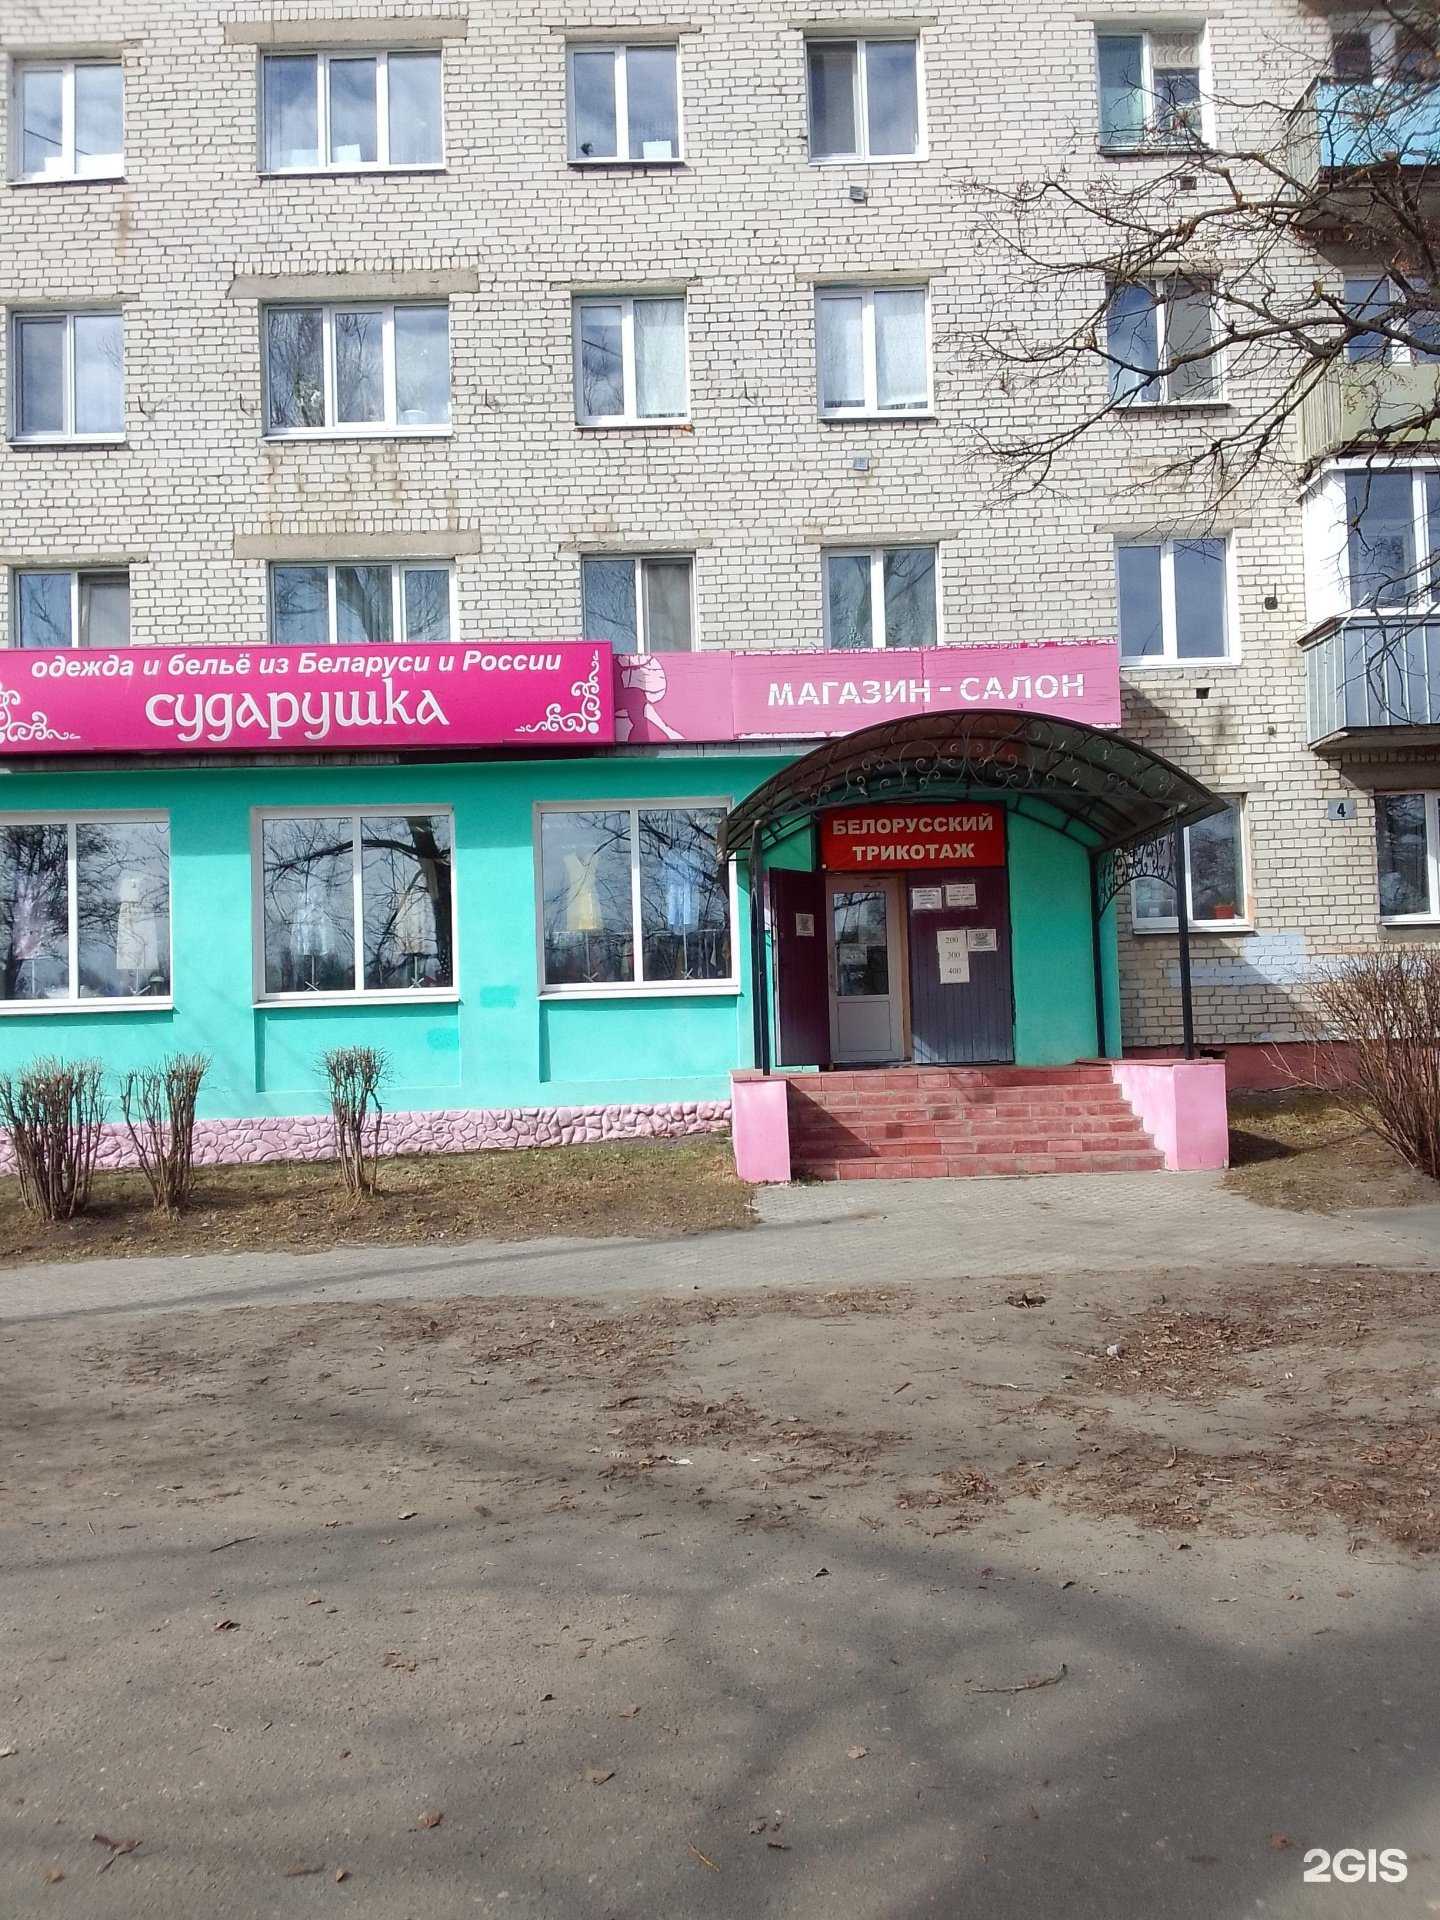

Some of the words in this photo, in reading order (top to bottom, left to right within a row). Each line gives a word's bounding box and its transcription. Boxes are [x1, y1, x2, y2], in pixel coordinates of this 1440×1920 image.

[31, 655, 134, 678] одежда
[143, 659, 160, 676] и
[168, 653, 250, 676] бельё
[259, 658, 289, 674] из
[298, 653, 430, 677] Беларуси
[438, 655, 455, 672] и
[462, 650, 561, 671] России
[145, 677, 449, 742] сударушка
[1336, 802, 1346, 818] 4
[832, 812, 993, 835] БЕЛОРУССКИЙ
[852, 843, 975, 861] ТРИКОТАЖ
